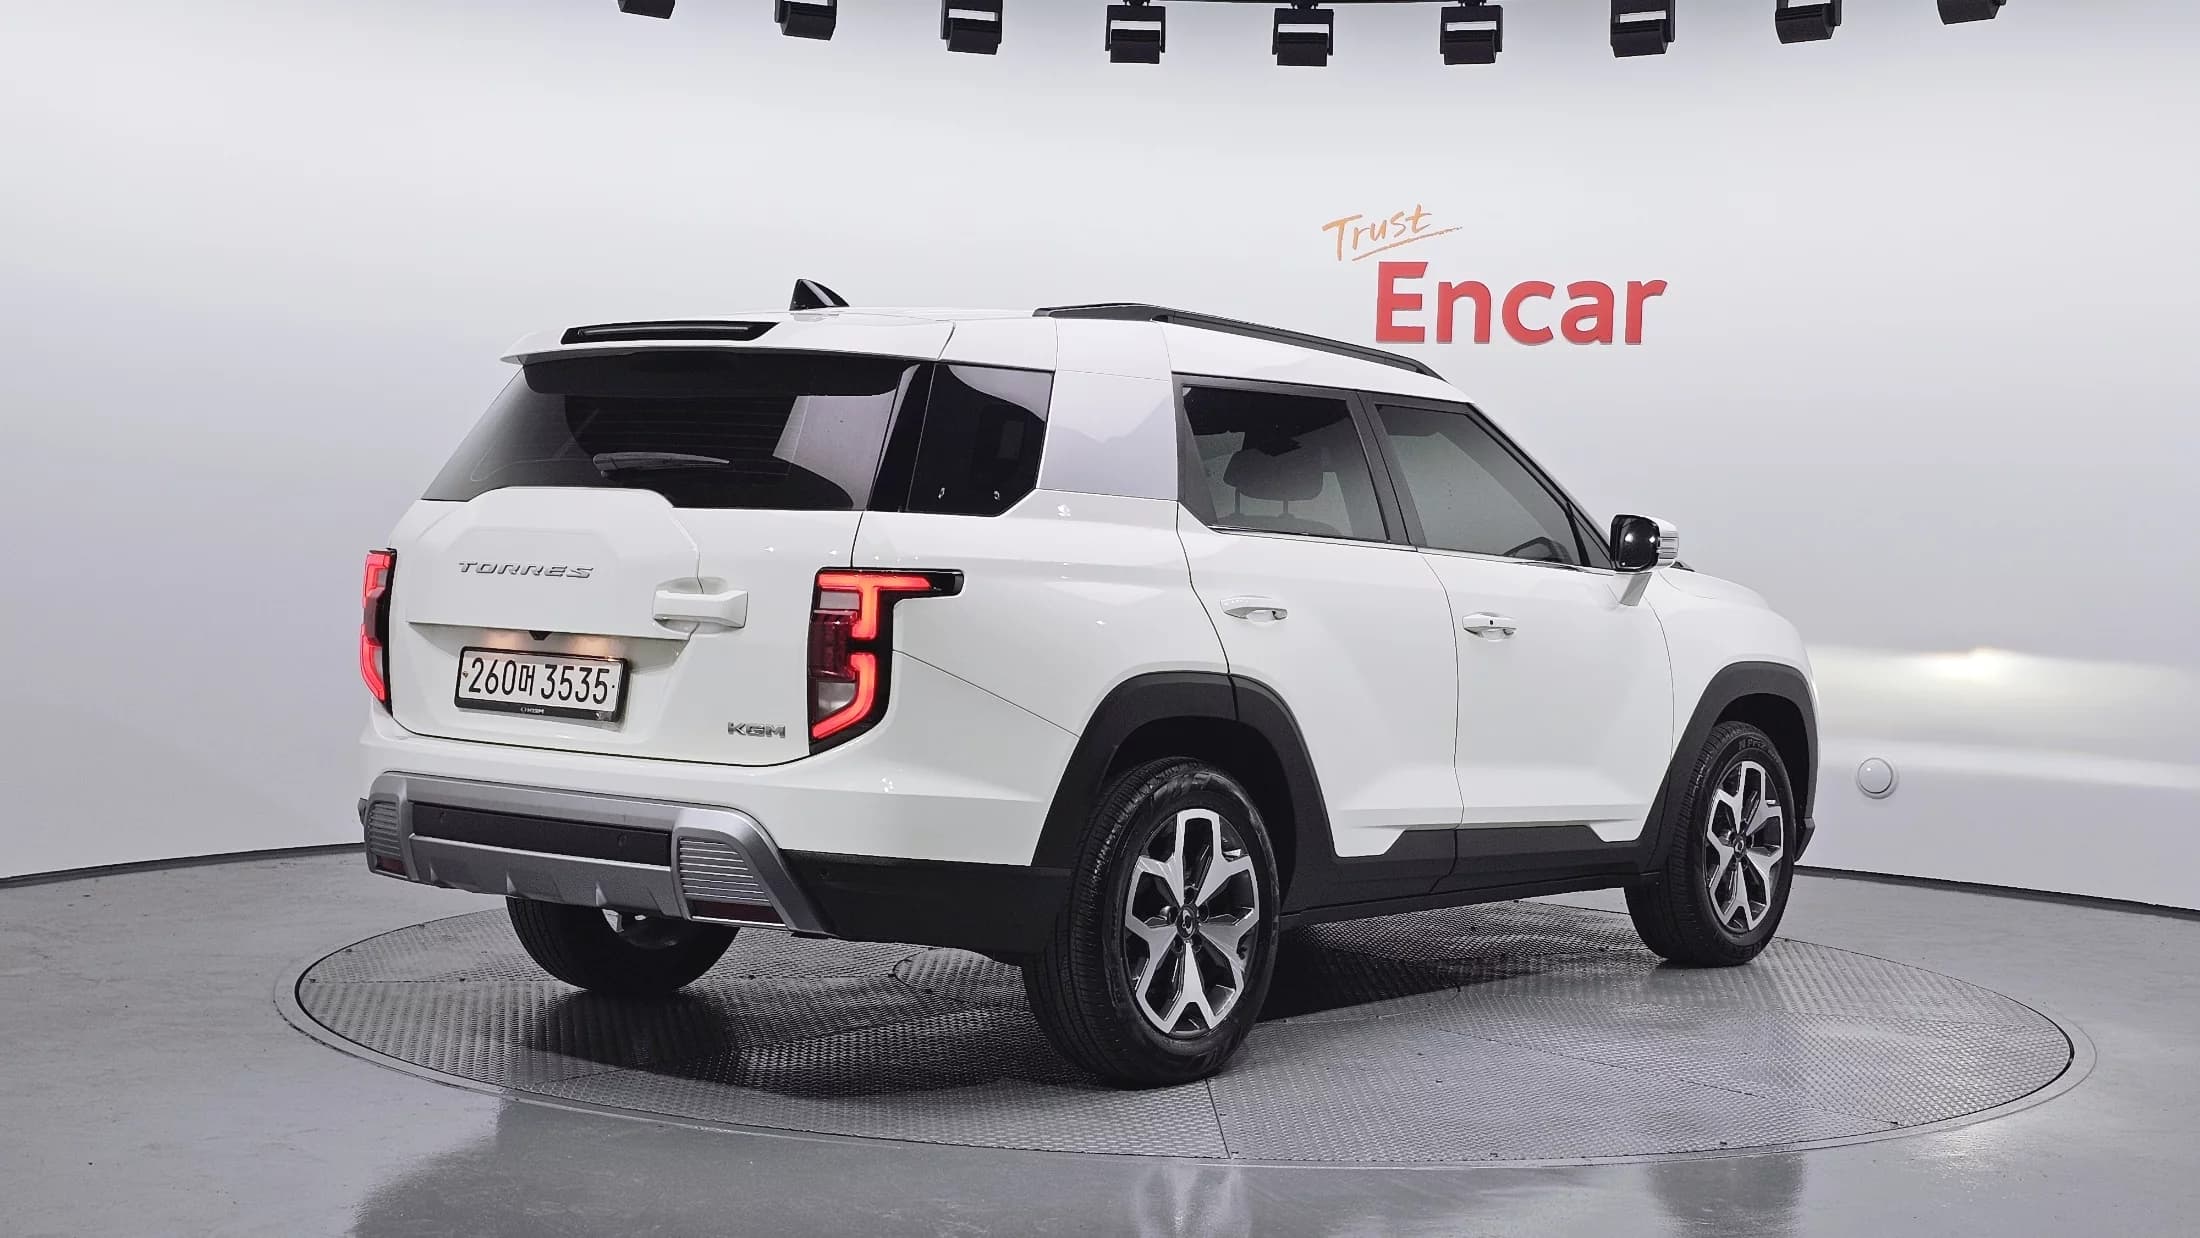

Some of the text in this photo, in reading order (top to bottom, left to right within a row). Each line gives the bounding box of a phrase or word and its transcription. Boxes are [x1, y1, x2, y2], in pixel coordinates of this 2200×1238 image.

[1322, 203, 1433, 262] Trust
[1375, 261, 1668, 345] Encar
[458, 560, 594, 579] TORRES
[468, 657, 610, 704] 260머 3535
[727, 721, 786, 739] KGM
